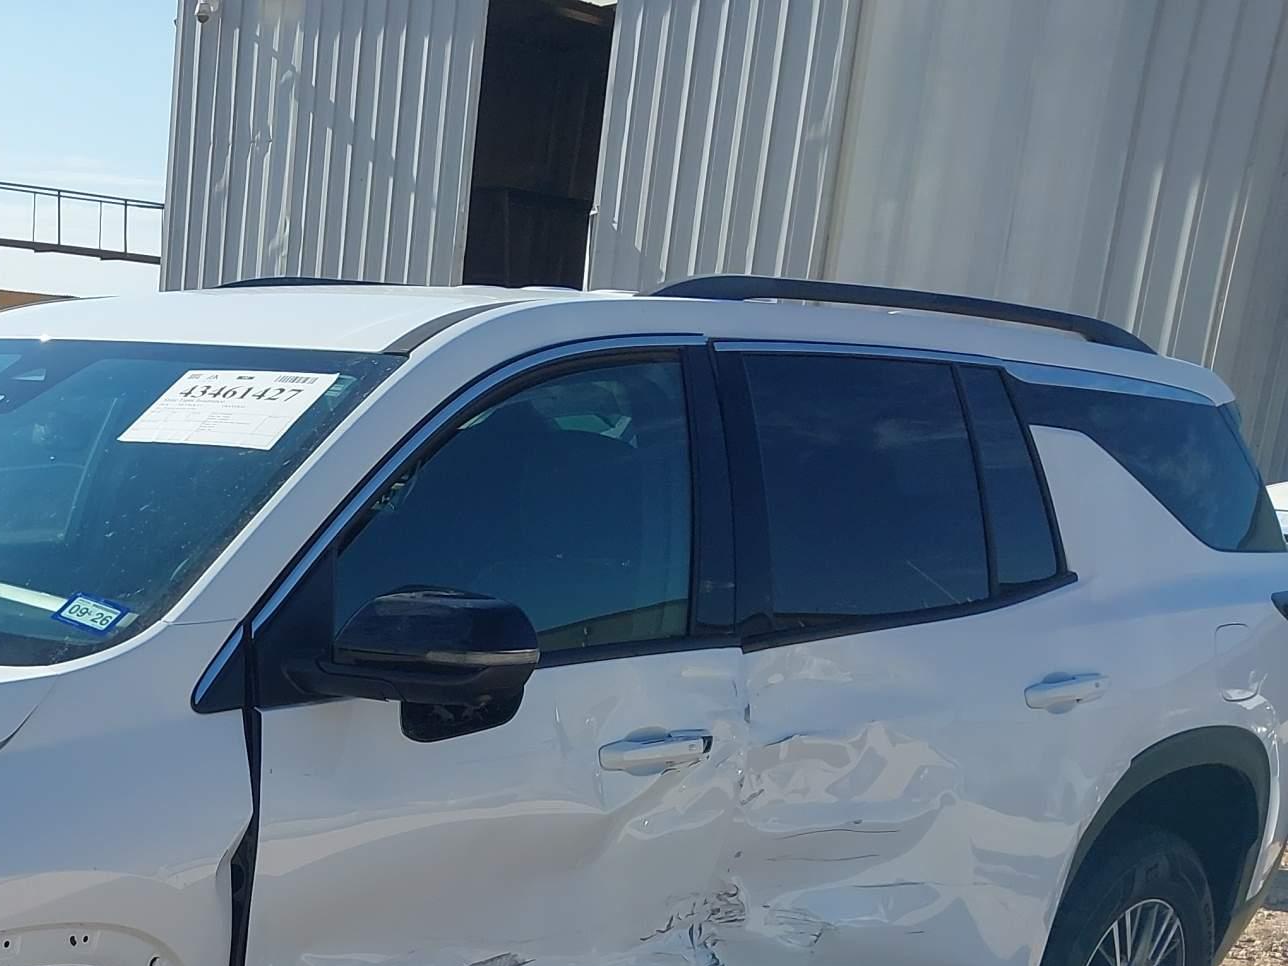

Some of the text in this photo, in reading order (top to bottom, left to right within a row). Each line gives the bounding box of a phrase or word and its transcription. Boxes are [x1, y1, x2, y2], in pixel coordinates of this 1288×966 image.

[179, 385, 304, 401] 43461427
[68, 604, 112, 626] 09 26
